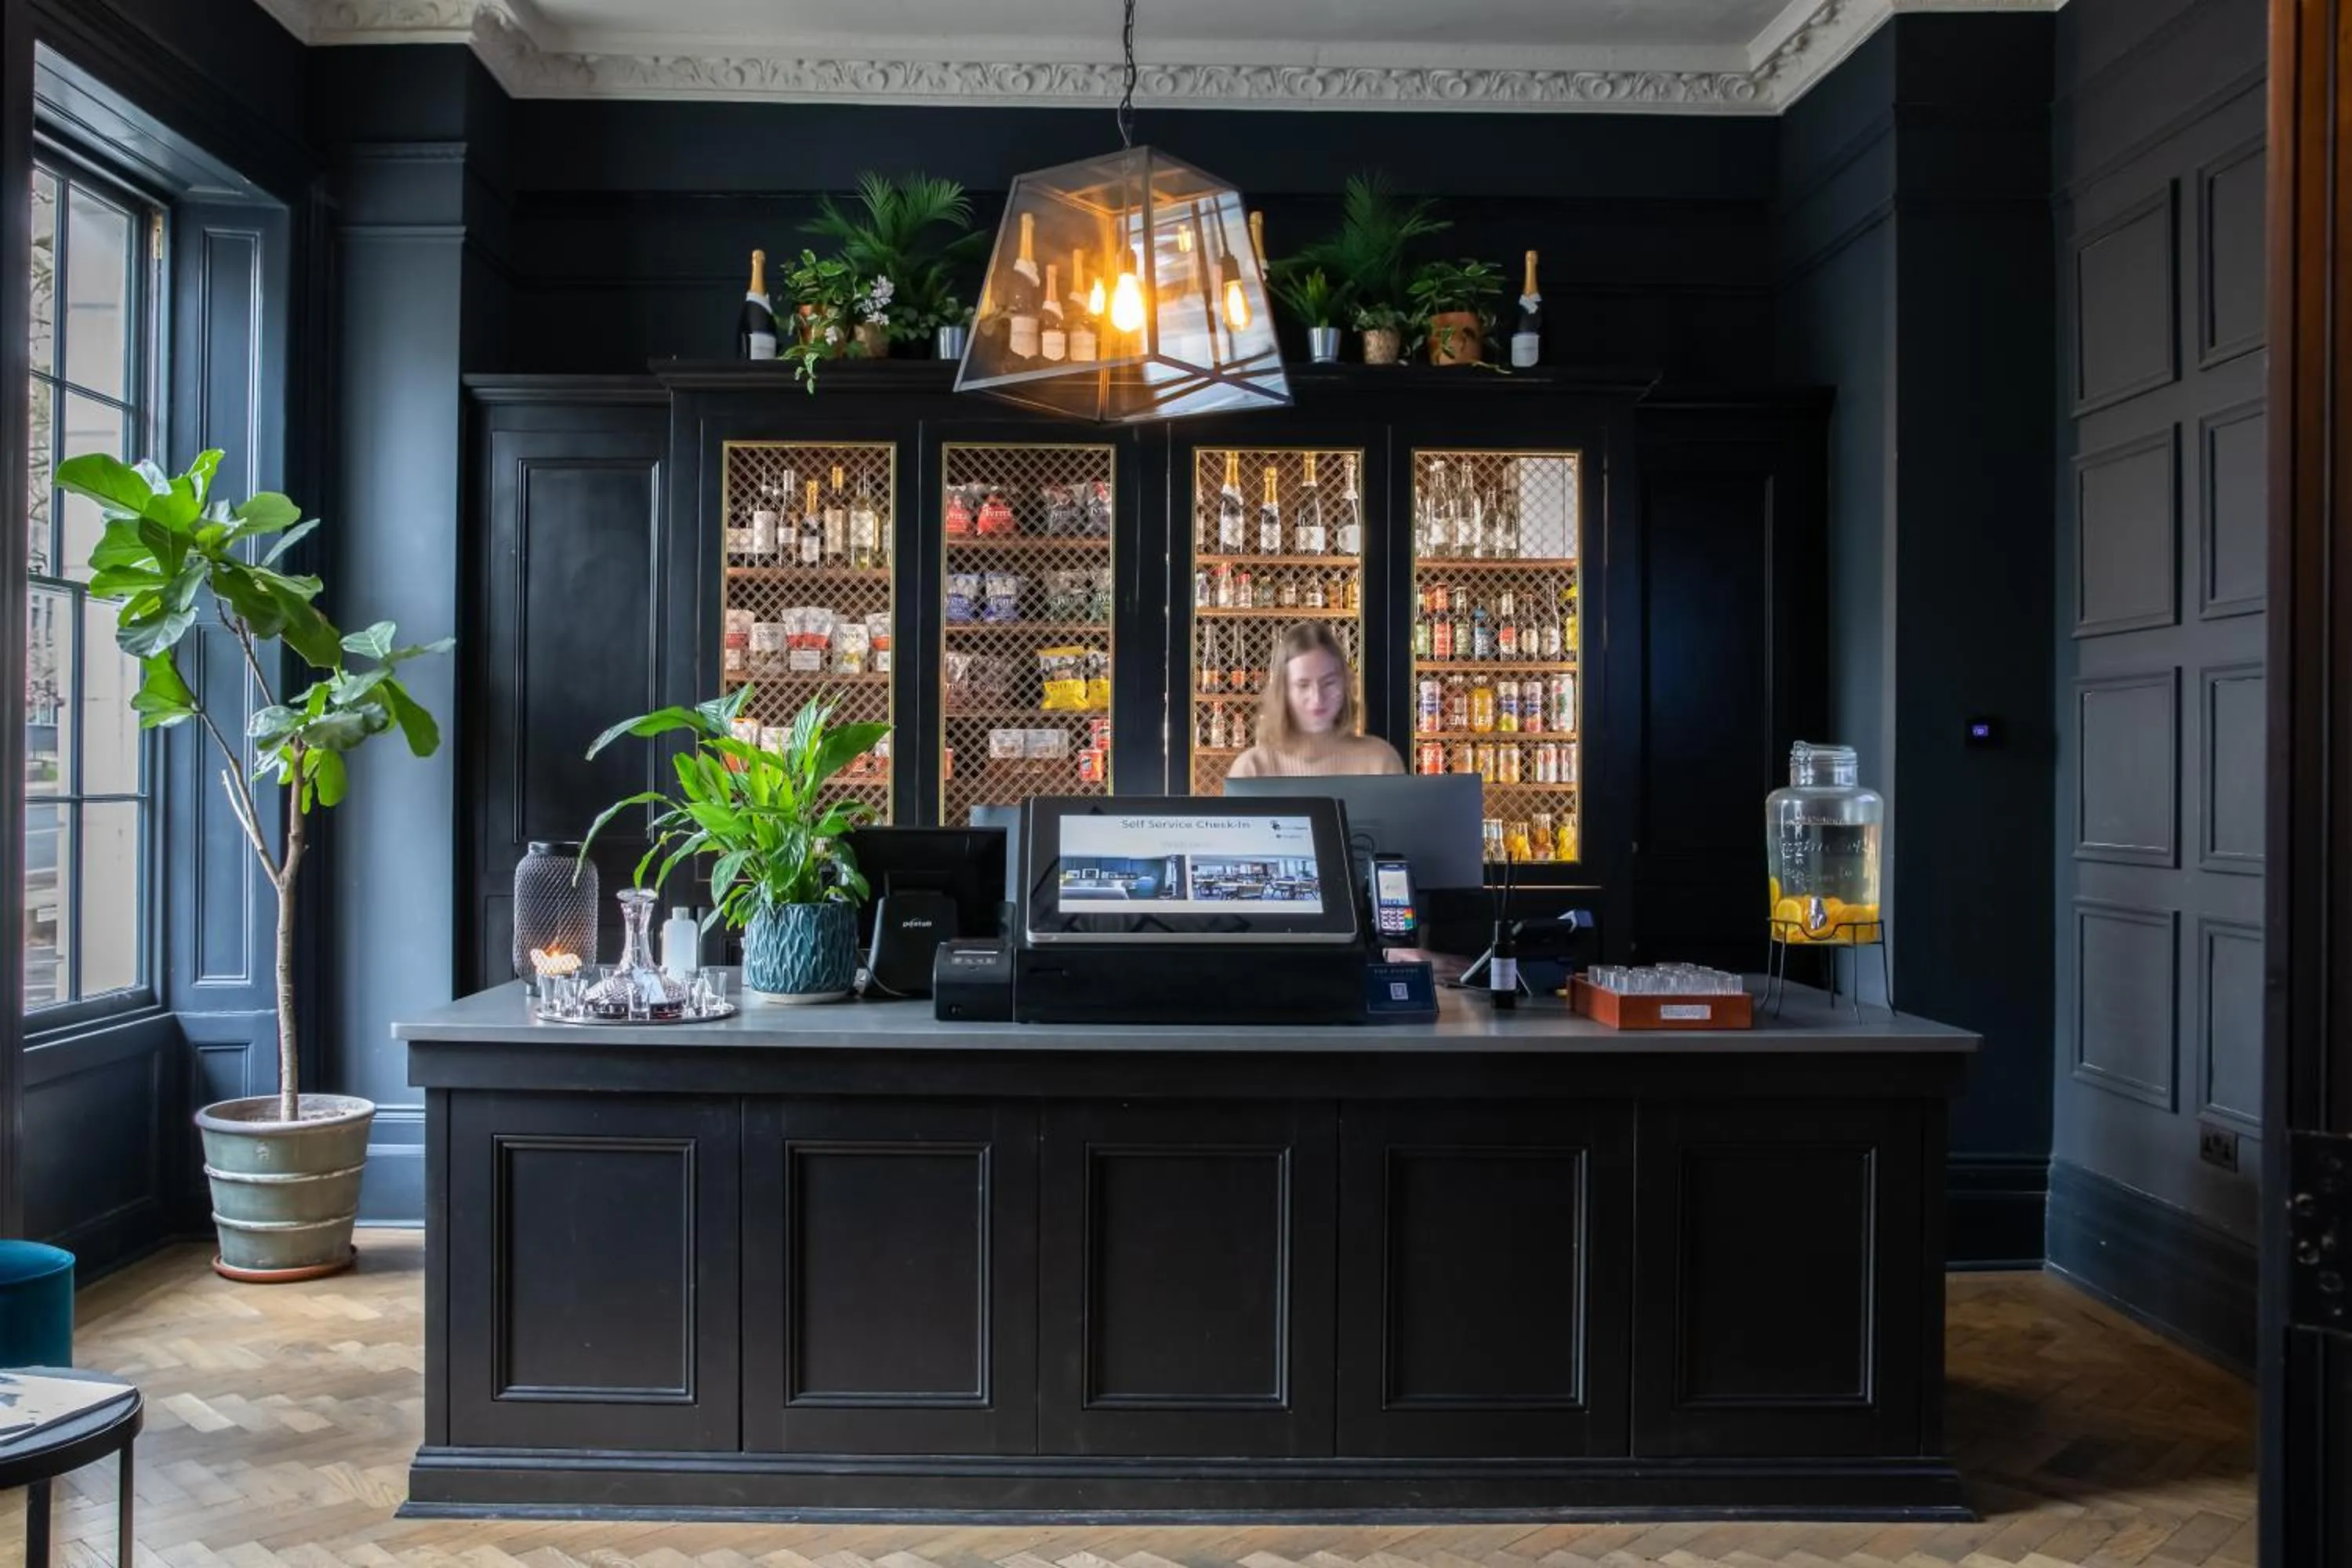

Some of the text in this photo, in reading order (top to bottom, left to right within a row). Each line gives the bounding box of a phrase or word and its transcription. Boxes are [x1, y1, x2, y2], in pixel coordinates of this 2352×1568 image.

[1121, 819, 1251, 829] Self Service Check-In
